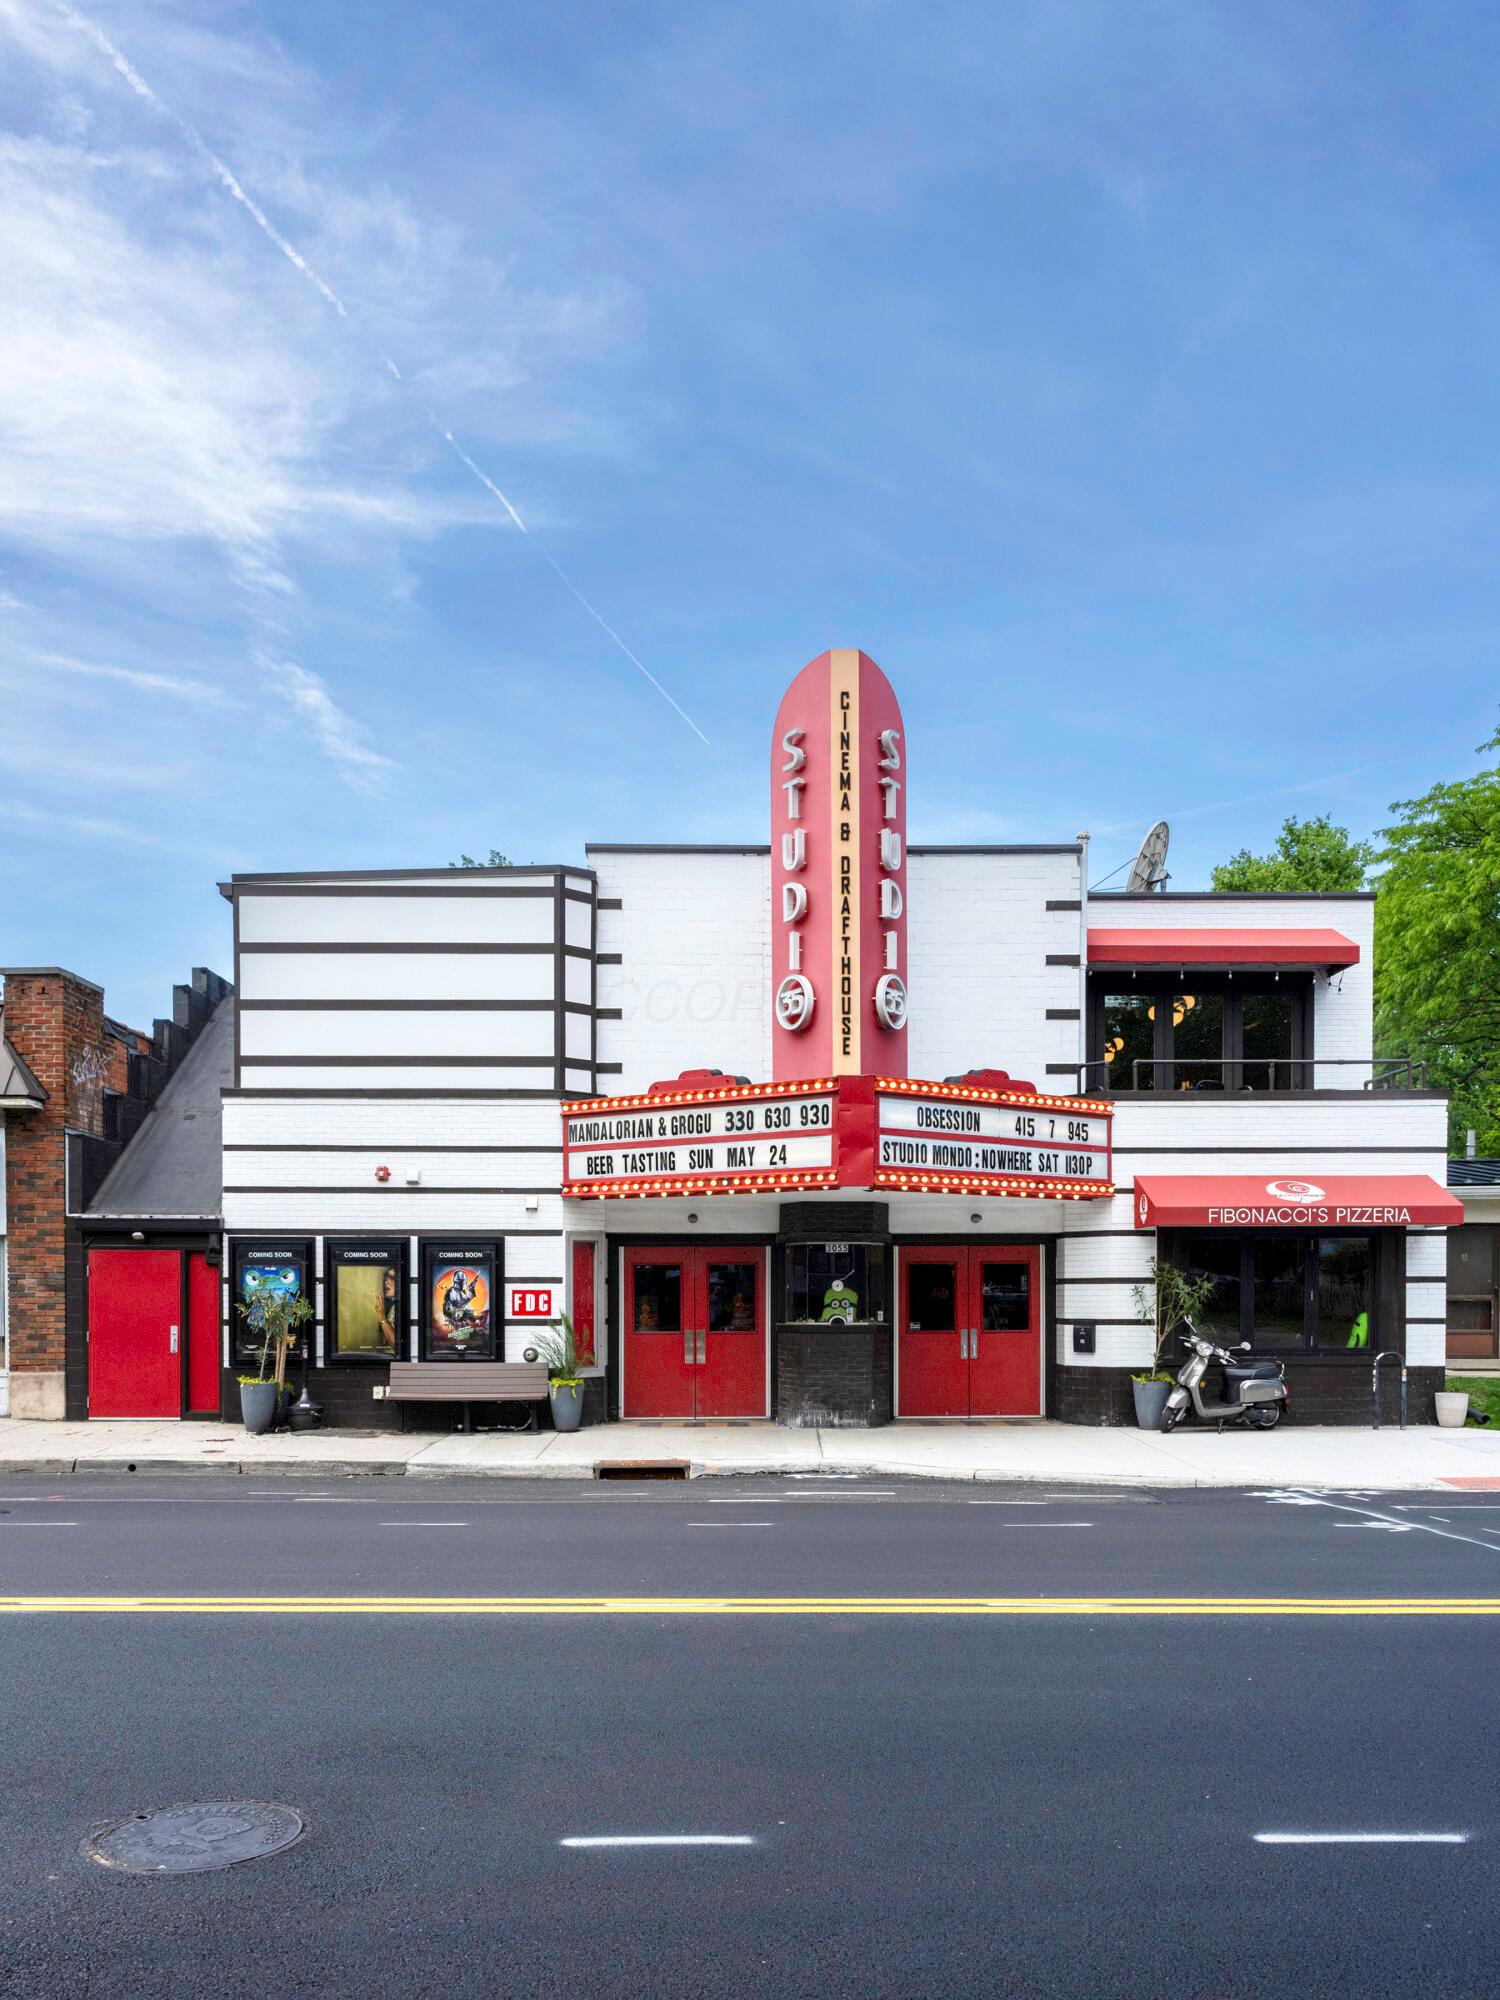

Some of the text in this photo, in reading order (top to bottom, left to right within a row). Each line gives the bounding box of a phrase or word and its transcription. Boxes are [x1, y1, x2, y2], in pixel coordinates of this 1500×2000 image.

[840, 691, 852, 1056] CINEMA & DRAFTHOUSE
[568, 1103, 830, 1143] MANDALORIAN & GROGU 330 630 930
[917, 1106, 1089, 1142] OBSESSION 415 7 945
[587, 1144, 787, 1175] BEER TASTING SUN MAY 24
[883, 1141, 927, 1165] STUDIO
[1038, 1152, 1059, 1173] SAT
[1208, 1207, 1411, 1223] FIBONACCI'S PIZZERIA
[826, 1244, 848, 1252] 3055
[514, 1293, 549, 1312] FDC
